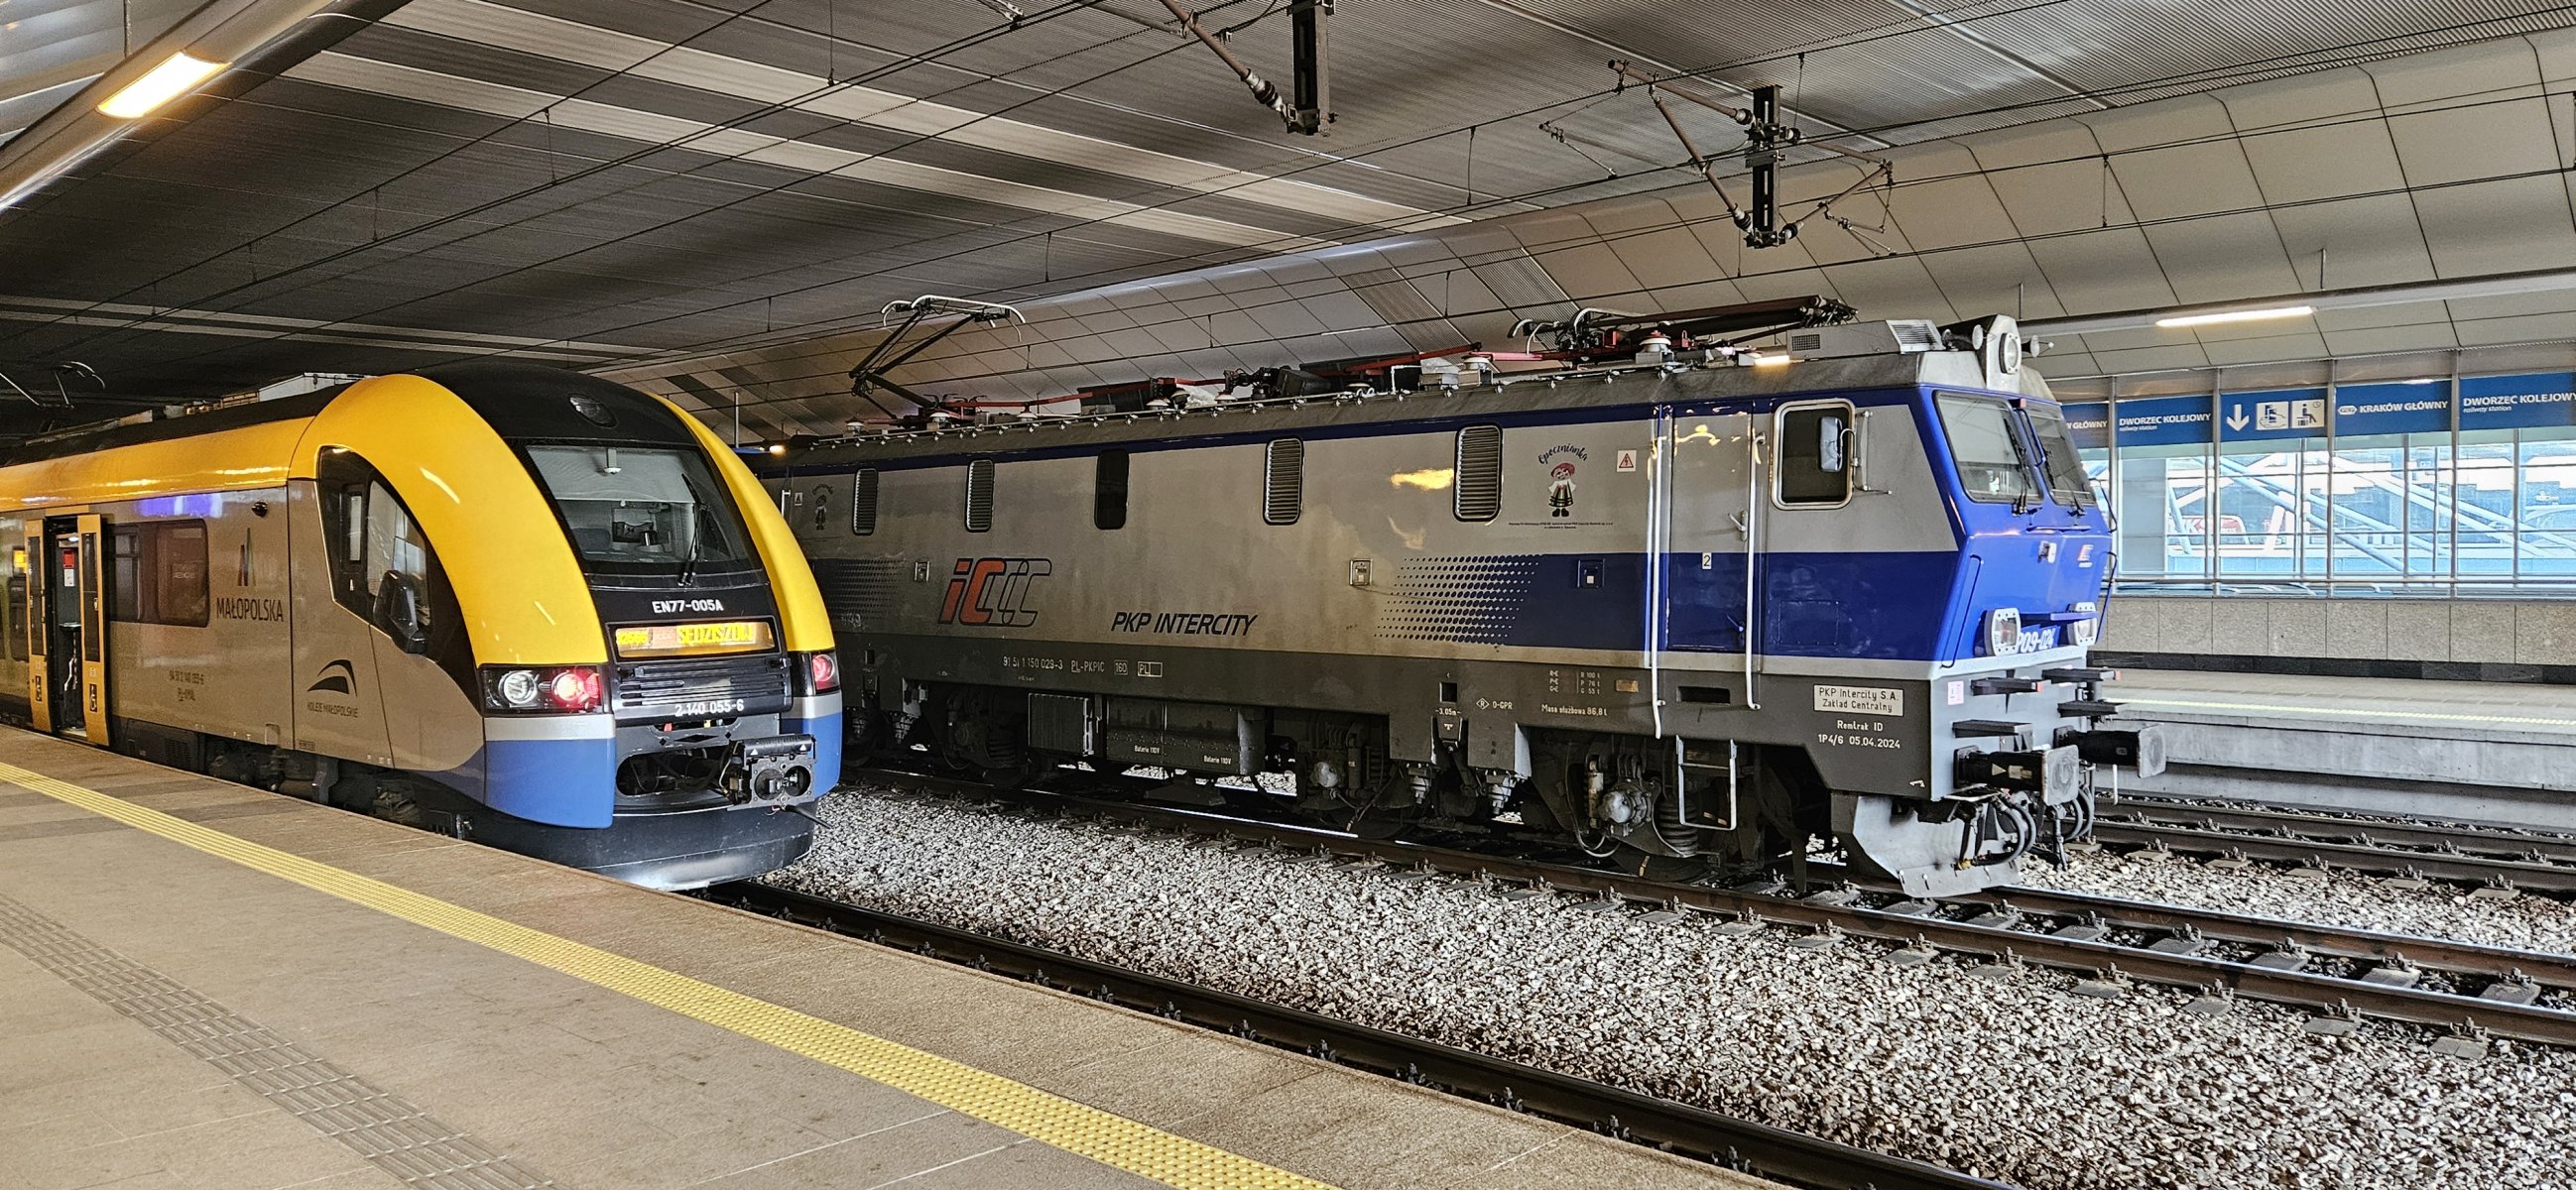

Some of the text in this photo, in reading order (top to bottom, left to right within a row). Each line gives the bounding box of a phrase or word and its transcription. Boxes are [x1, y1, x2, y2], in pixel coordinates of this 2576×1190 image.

[2463, 393, 2576, 406] DWORZEC KOLEJOWY
[2360, 403, 2403, 413] KRAKÓW
[2404, 401, 2448, 411] GŁÓWNY
[2073, 420, 2108, 429] GŁÓWNY
[2119, 413, 2211, 426] DWORZEC KOLEJOWY
[1704, 555, 1711, 566] 2
[217, 597, 284, 622] MAŁOPOLSKA
[652, 599, 724, 613] EN77-005A
[1110, 611, 1258, 636] PKP INTERCITY
[1003, 656, 1011, 667] 91
[1071, 660, 1104, 673] PL-PKPIC
[1115, 662, 1127, 673] 160
[1139, 663, 1149, 674] PL
[1819, 687, 1899, 701] PKP Intercity S.A.
[675, 699, 744, 716] 2 140 055-6
[1541, 704, 1558, 713] Masa
[1851, 701, 1893, 713] Centralny
[1837, 720, 1883, 731] Remtrak ID
[1818, 734, 1900, 749] 1P4/6 05.04.2024
